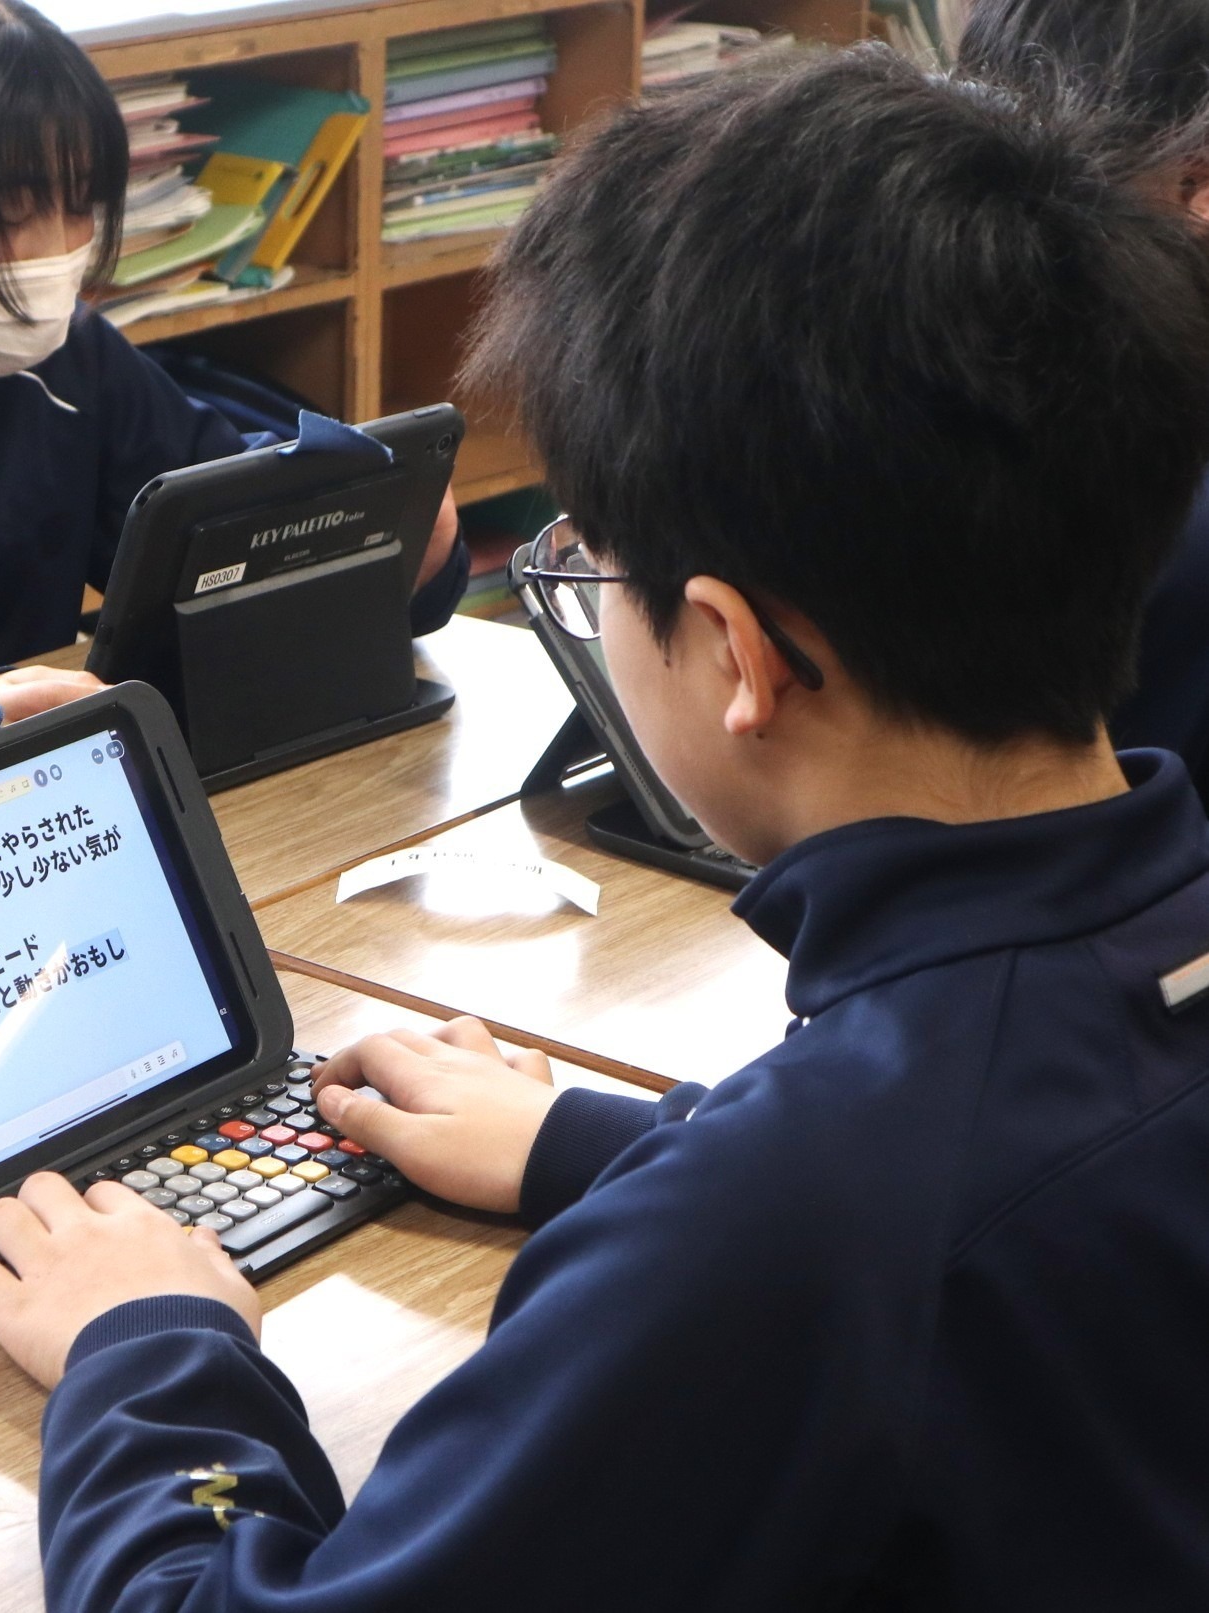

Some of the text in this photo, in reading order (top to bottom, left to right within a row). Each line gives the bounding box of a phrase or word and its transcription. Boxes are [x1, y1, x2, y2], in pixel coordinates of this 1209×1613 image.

[250, 526, 282, 549] KEY
[281, 510, 344, 541] PALETTO
[200, 567, 240, 589] HS0307
